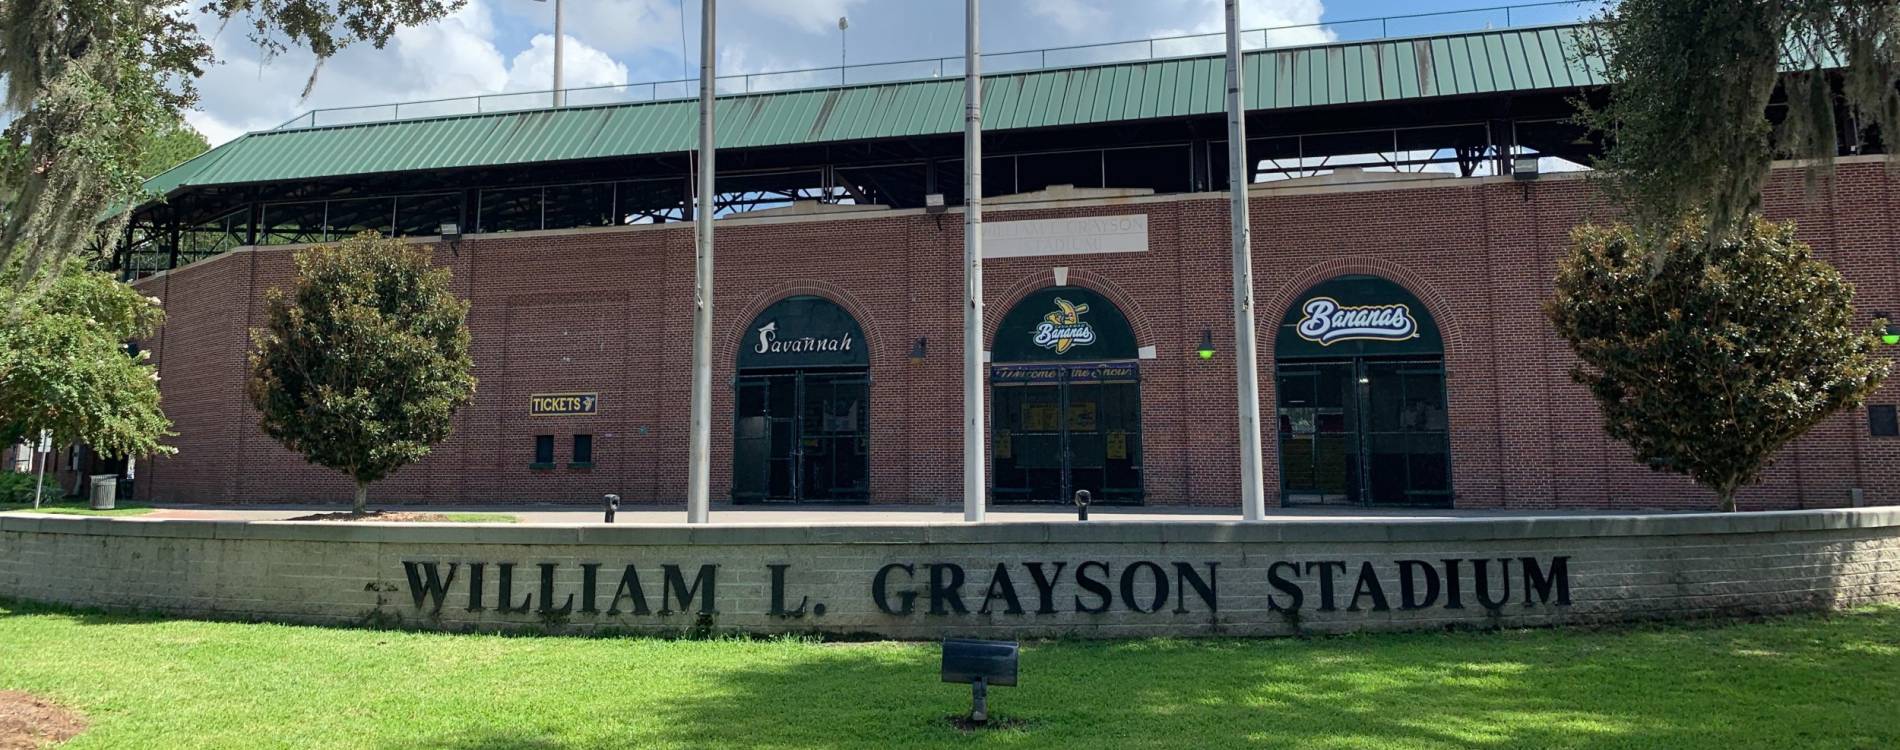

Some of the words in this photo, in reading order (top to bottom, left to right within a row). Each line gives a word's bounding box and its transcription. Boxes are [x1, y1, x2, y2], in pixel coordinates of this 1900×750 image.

[1034, 323, 1093, 343] Bananas
[1300, 300, 1411, 341] Bananas
[754, 321, 852, 354] Savannah
[533, 397, 581, 412] TICKETS
[402, 561, 719, 617] WILLIAM
[766, 563, 827, 616] L.
[871, 560, 1222, 616] GRAYSON
[1267, 555, 1572, 614] STADIUM
